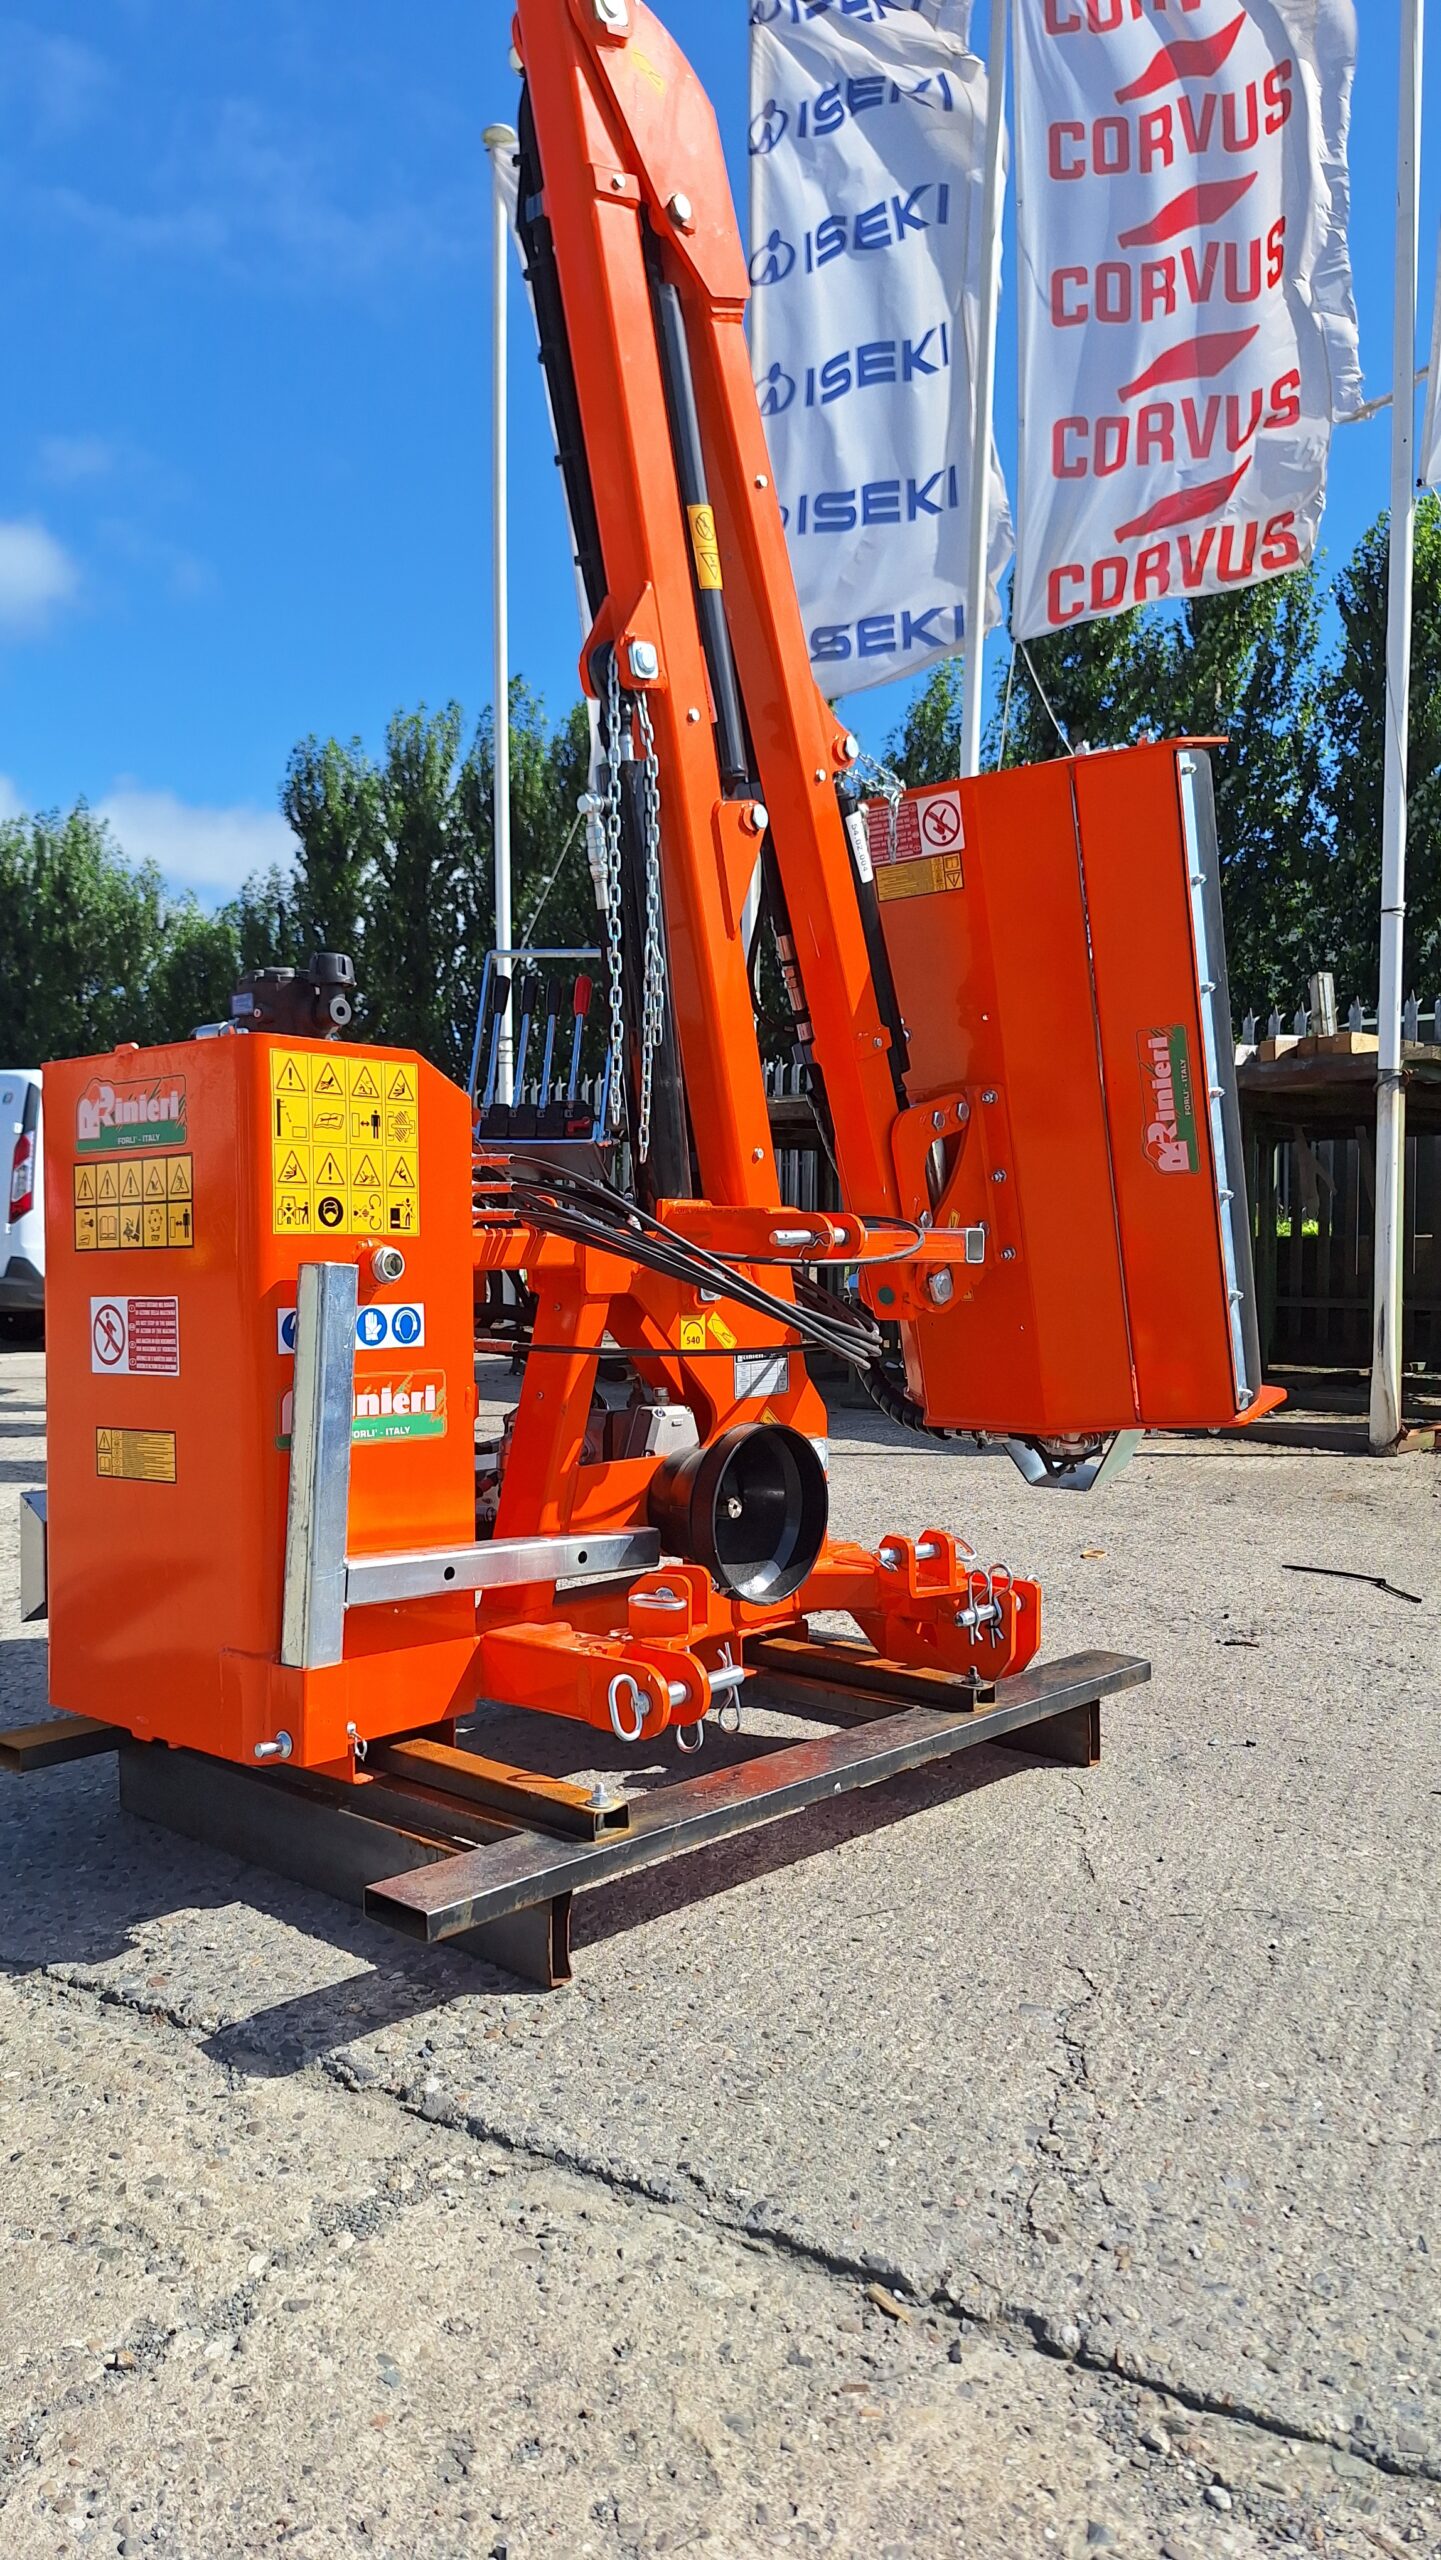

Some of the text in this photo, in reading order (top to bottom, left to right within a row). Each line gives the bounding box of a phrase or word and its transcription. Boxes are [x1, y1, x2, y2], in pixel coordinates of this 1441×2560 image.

[797, 72, 954, 138] ISEKI
[1048, 58, 1293, 181] CORVUS
[804, 183, 949, 274] ISEKI
[1050, 215, 1286, 329] CORVUS
[805, 321, 949, 408] ISEKI
[1052, 368, 1301, 480] CORVUS
[797, 464, 959, 536] ISEKI
[1047, 510, 1300, 626] CORVUS
[810, 604, 965, 663] SEKI
[1179, 1058, 1188, 1083] ITALY
[142, 1133, 161, 1143] ITALY
[686, 1336, 701, 1345] 540
[385, 1425, 411, 1436] ITALY
